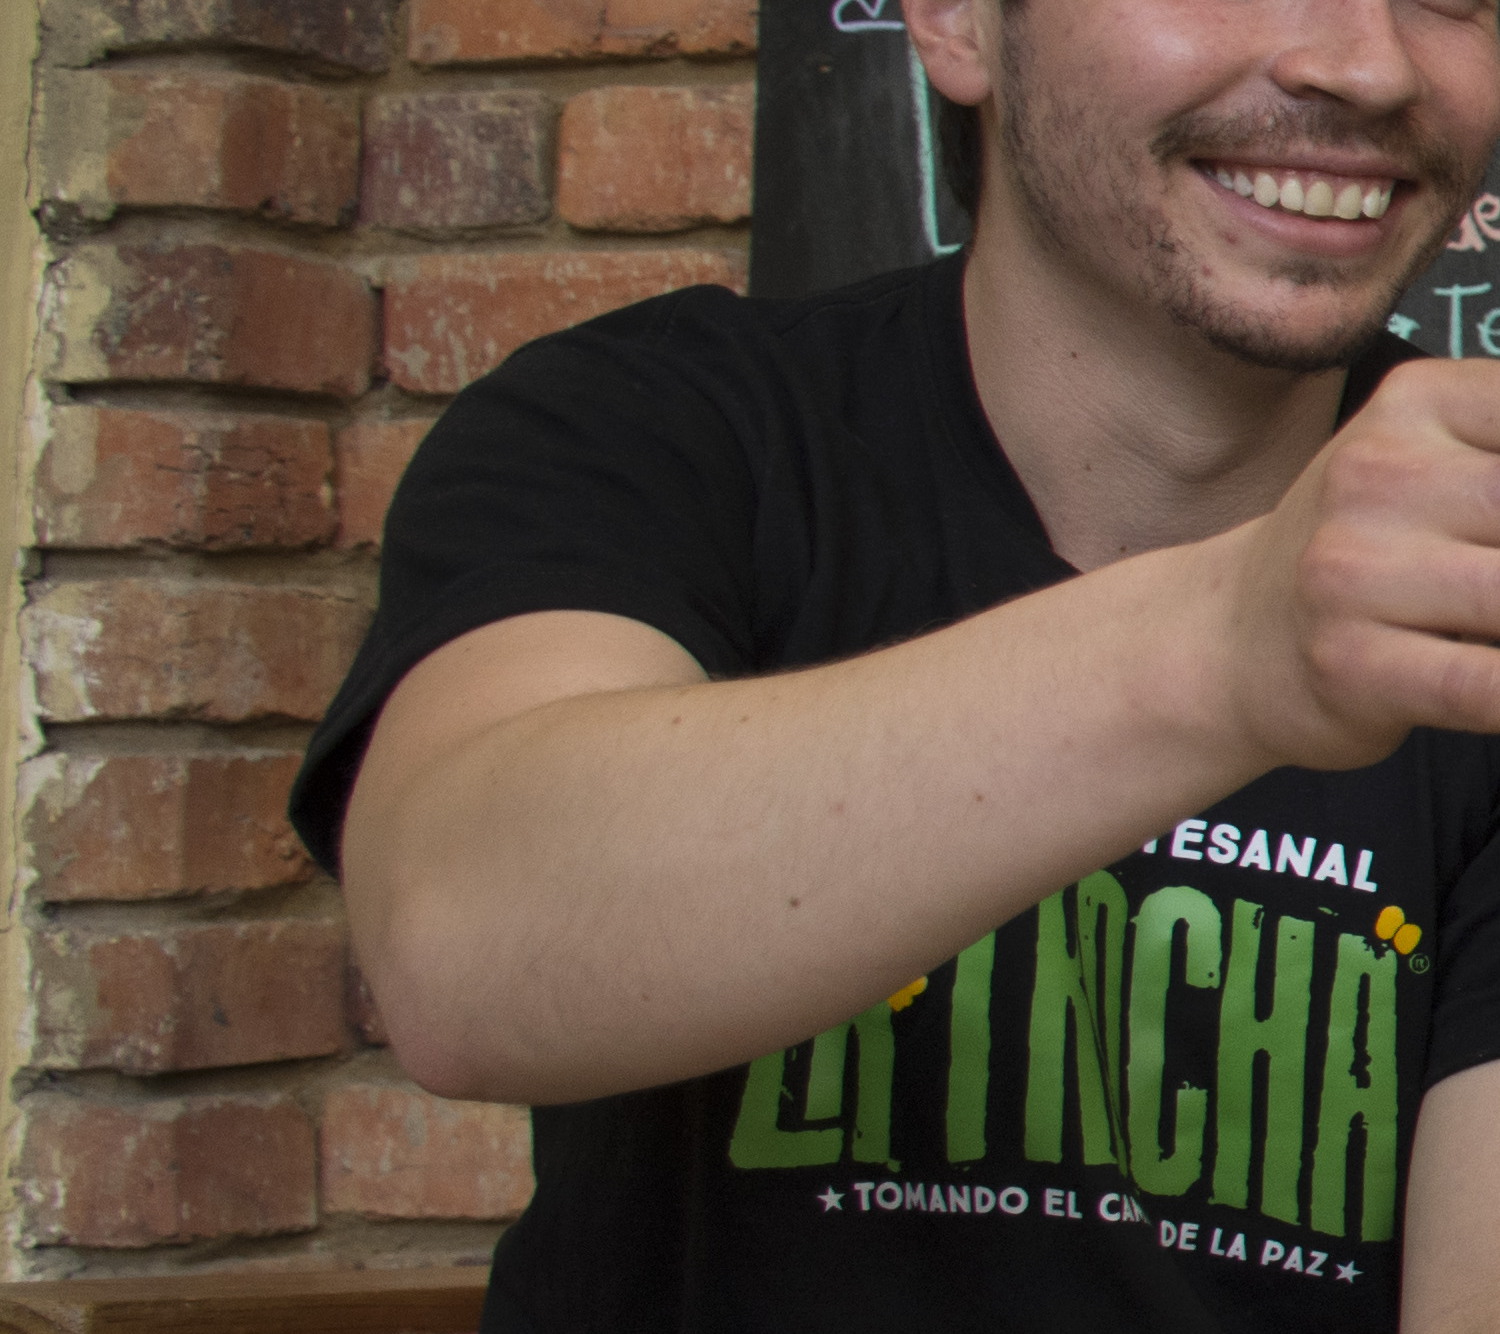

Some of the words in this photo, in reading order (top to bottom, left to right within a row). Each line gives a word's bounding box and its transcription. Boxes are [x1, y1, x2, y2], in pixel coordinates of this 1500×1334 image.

[854, 1182, 1028, 1214] TOMANDO
[1044, 1188, 1082, 1219] EL
[1160, 1220, 1198, 1251] DE
[1210, 1228, 1247, 1261] LA
[1261, 1240, 1329, 1277] PAZ
